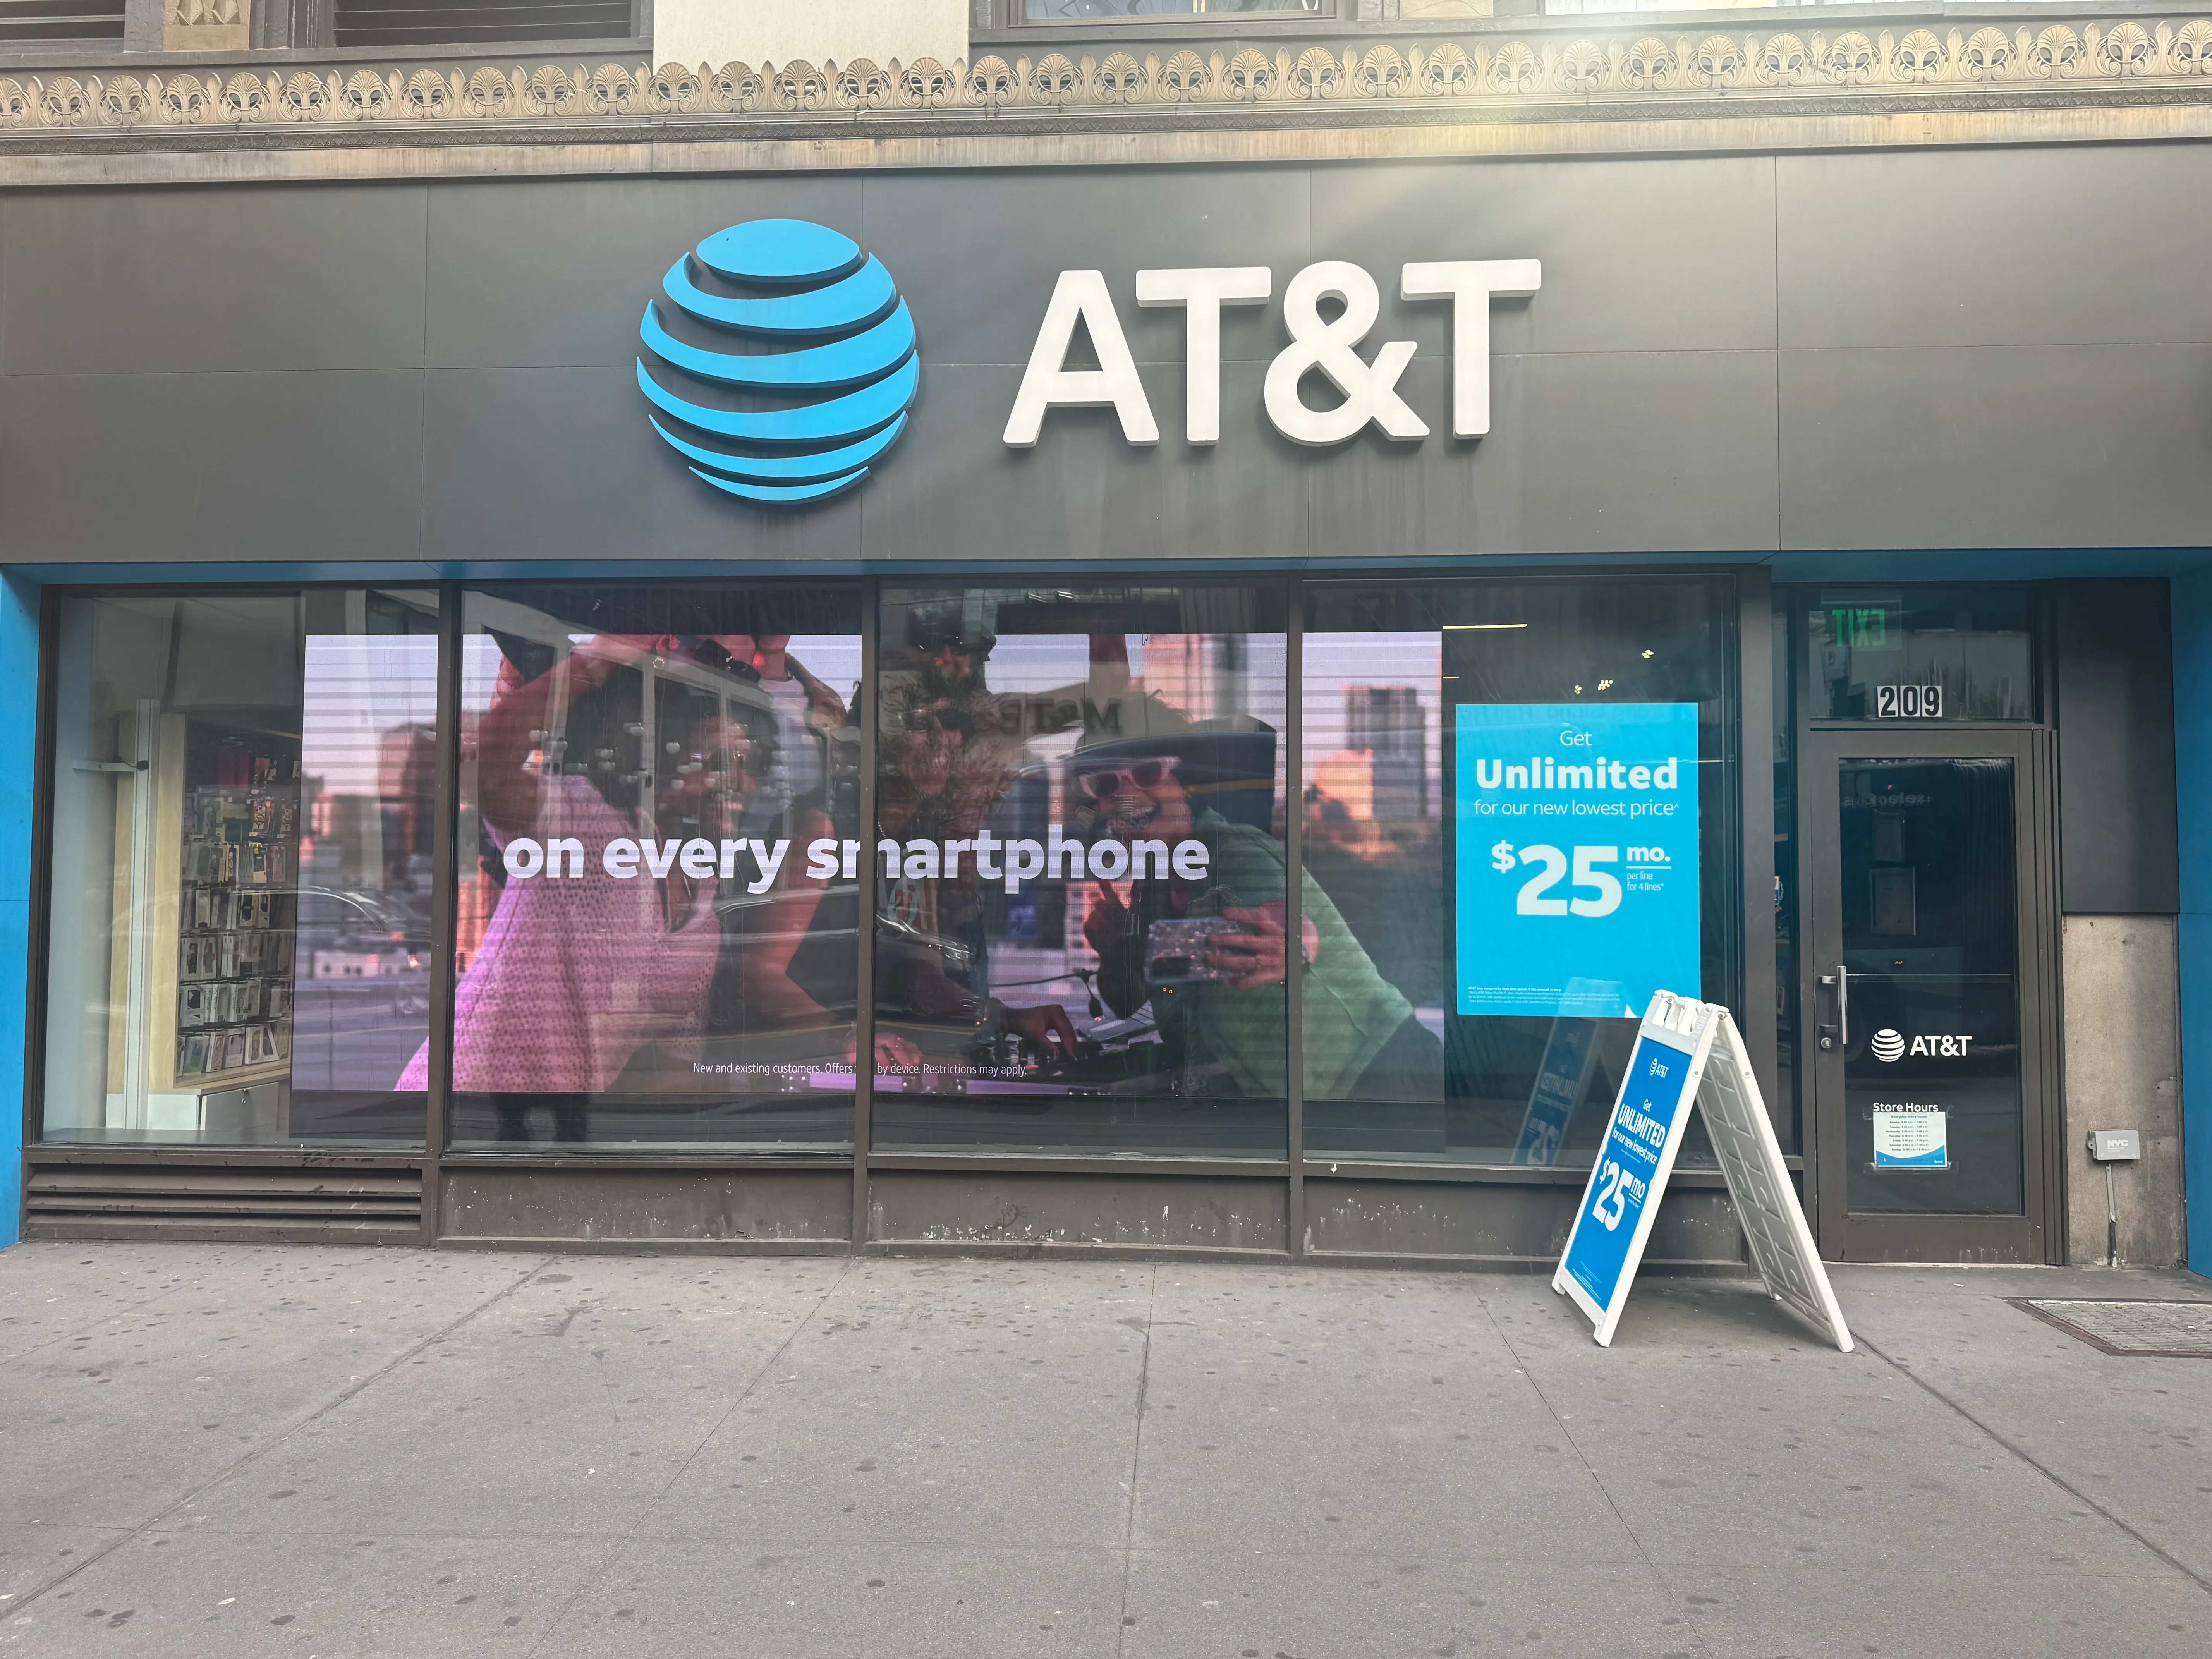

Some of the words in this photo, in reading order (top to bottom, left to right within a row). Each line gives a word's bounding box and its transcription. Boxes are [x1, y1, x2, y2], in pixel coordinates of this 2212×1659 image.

[1002, 259, 1542, 448] AT&T
[1880, 686, 1940, 716] 209
[1560, 730, 1592, 746] Get
[1476, 756, 1678, 790] Unlimited
[1474, 799, 1497, 815] for
[1501, 803, 1529, 815] our
[1534, 804, 1567, 815] new
[1572, 800, 1627, 815] lowest
[503, 837, 584, 879] on
[603, 838, 791, 894] every
[1627, 873, 1639, 881] per
[1640, 871, 1653, 880] line
[1491, 839, 1623, 917] $25
[1627, 847, 1671, 862] mo.
[1627, 881, 1638, 891] for
[1638, 882, 1644, 890] 4
[1910, 1035, 1972, 1056] AT&T
[694, 1063, 713, 1073] New
[716, 1062, 732, 1073] and
[735, 1063, 770, 1076] existing
[773, 1063, 823, 1073] customers.
[825, 1063, 853, 1073] Offers
[877, 1063, 888, 1076] by
[891, 1063, 921, 1074] device.
[924, 1063, 977, 1074] Restrictions
[979, 1066, 998, 1077] may
[1001, 1064, 1027, 1077] apply.
[1654, 1063, 1669, 1079] AT&T
[1643, 1099, 1652, 1112] Get
[1873, 1102, 1903, 1112] Store
[1906, 1103, 1939, 1112] Hours
[1618, 1103, 1666, 1148] UNLIMITED
[1618, 1132, 1626, 1144] our
[1625, 1136, 1634, 1149] new
[1632, 1139, 1647, 1158] lowest
[1592, 1156, 1634, 1231] $25
[1630, 1177, 1645, 1199] mo
